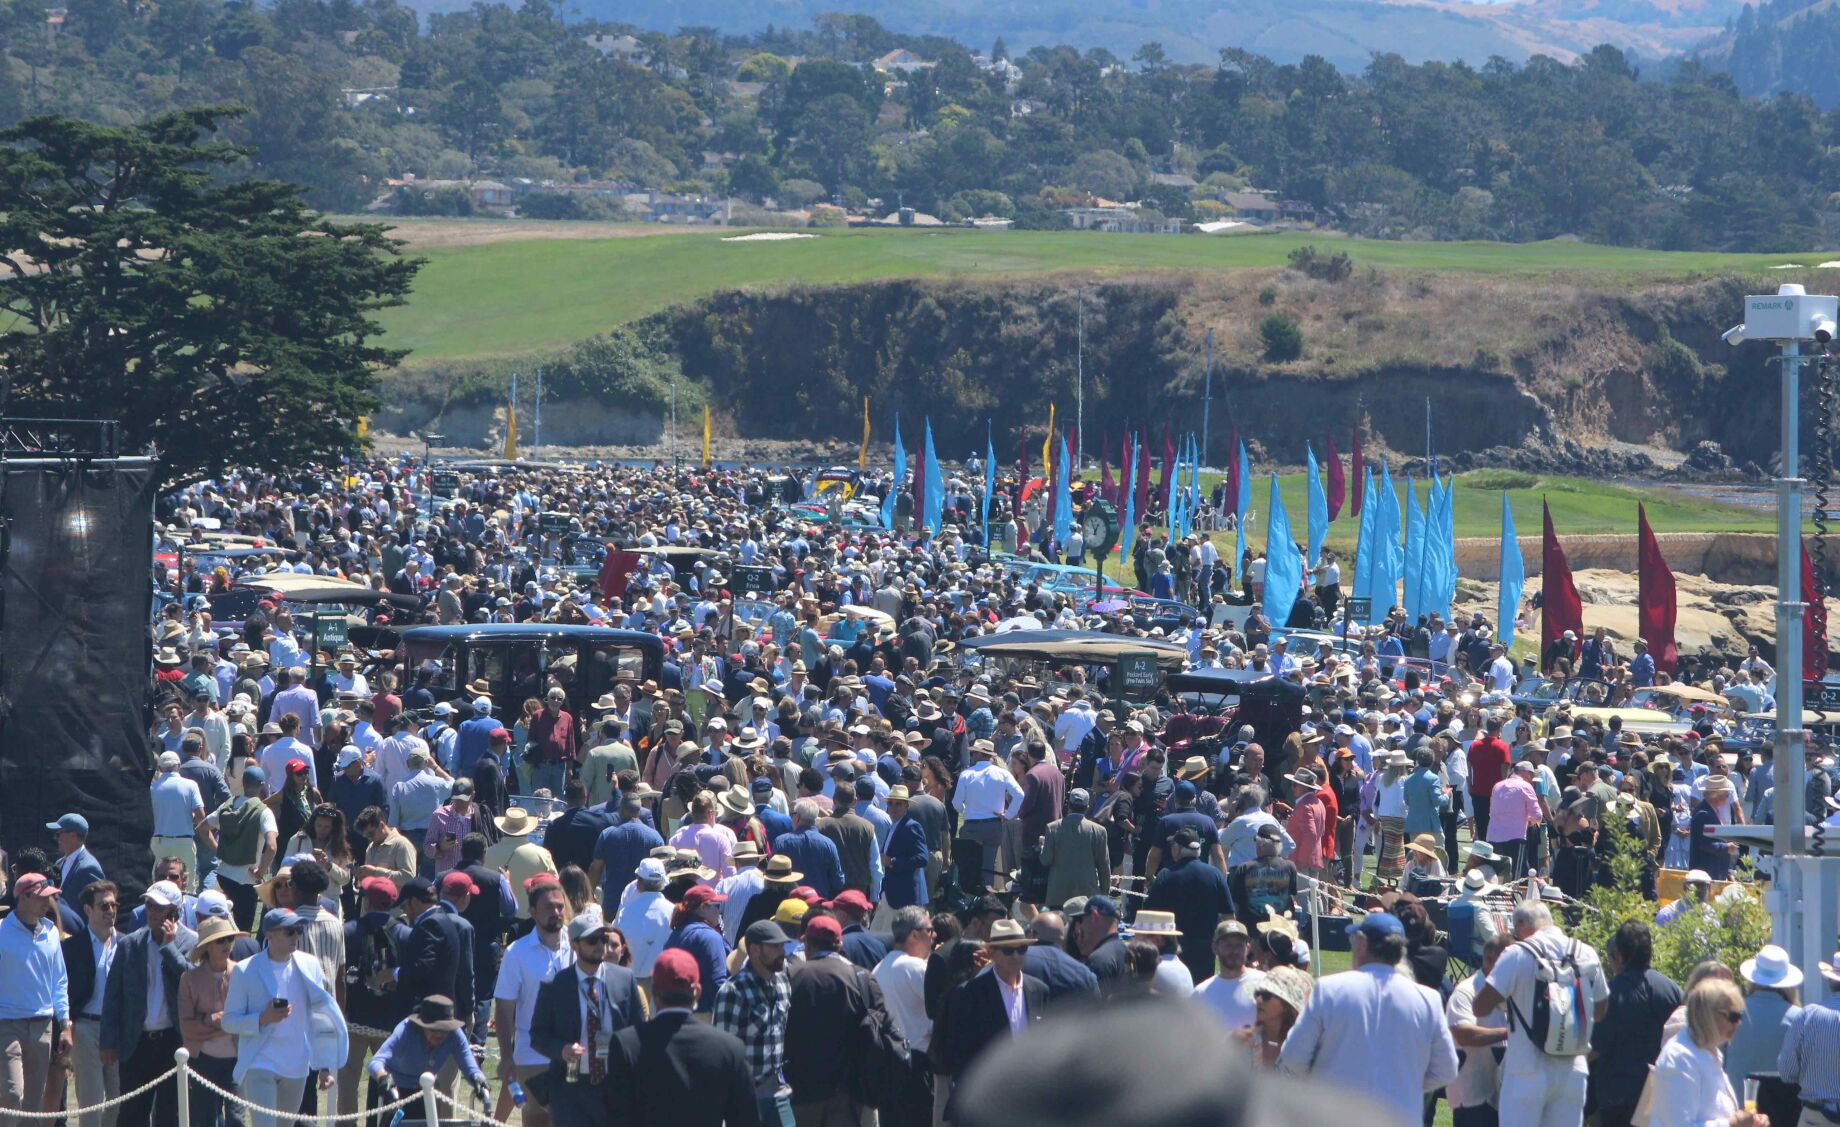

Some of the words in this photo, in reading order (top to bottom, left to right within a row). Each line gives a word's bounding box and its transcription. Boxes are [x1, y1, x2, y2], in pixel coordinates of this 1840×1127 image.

[1751, 302, 1782, 310] REMARK
[747, 574, 760, 582] Q-2
[328, 622, 338, 631] A-1
[323, 632, 344, 643] Antique
[1134, 661, 1146, 670] A-2
[1143, 671, 1154, 679] Early
